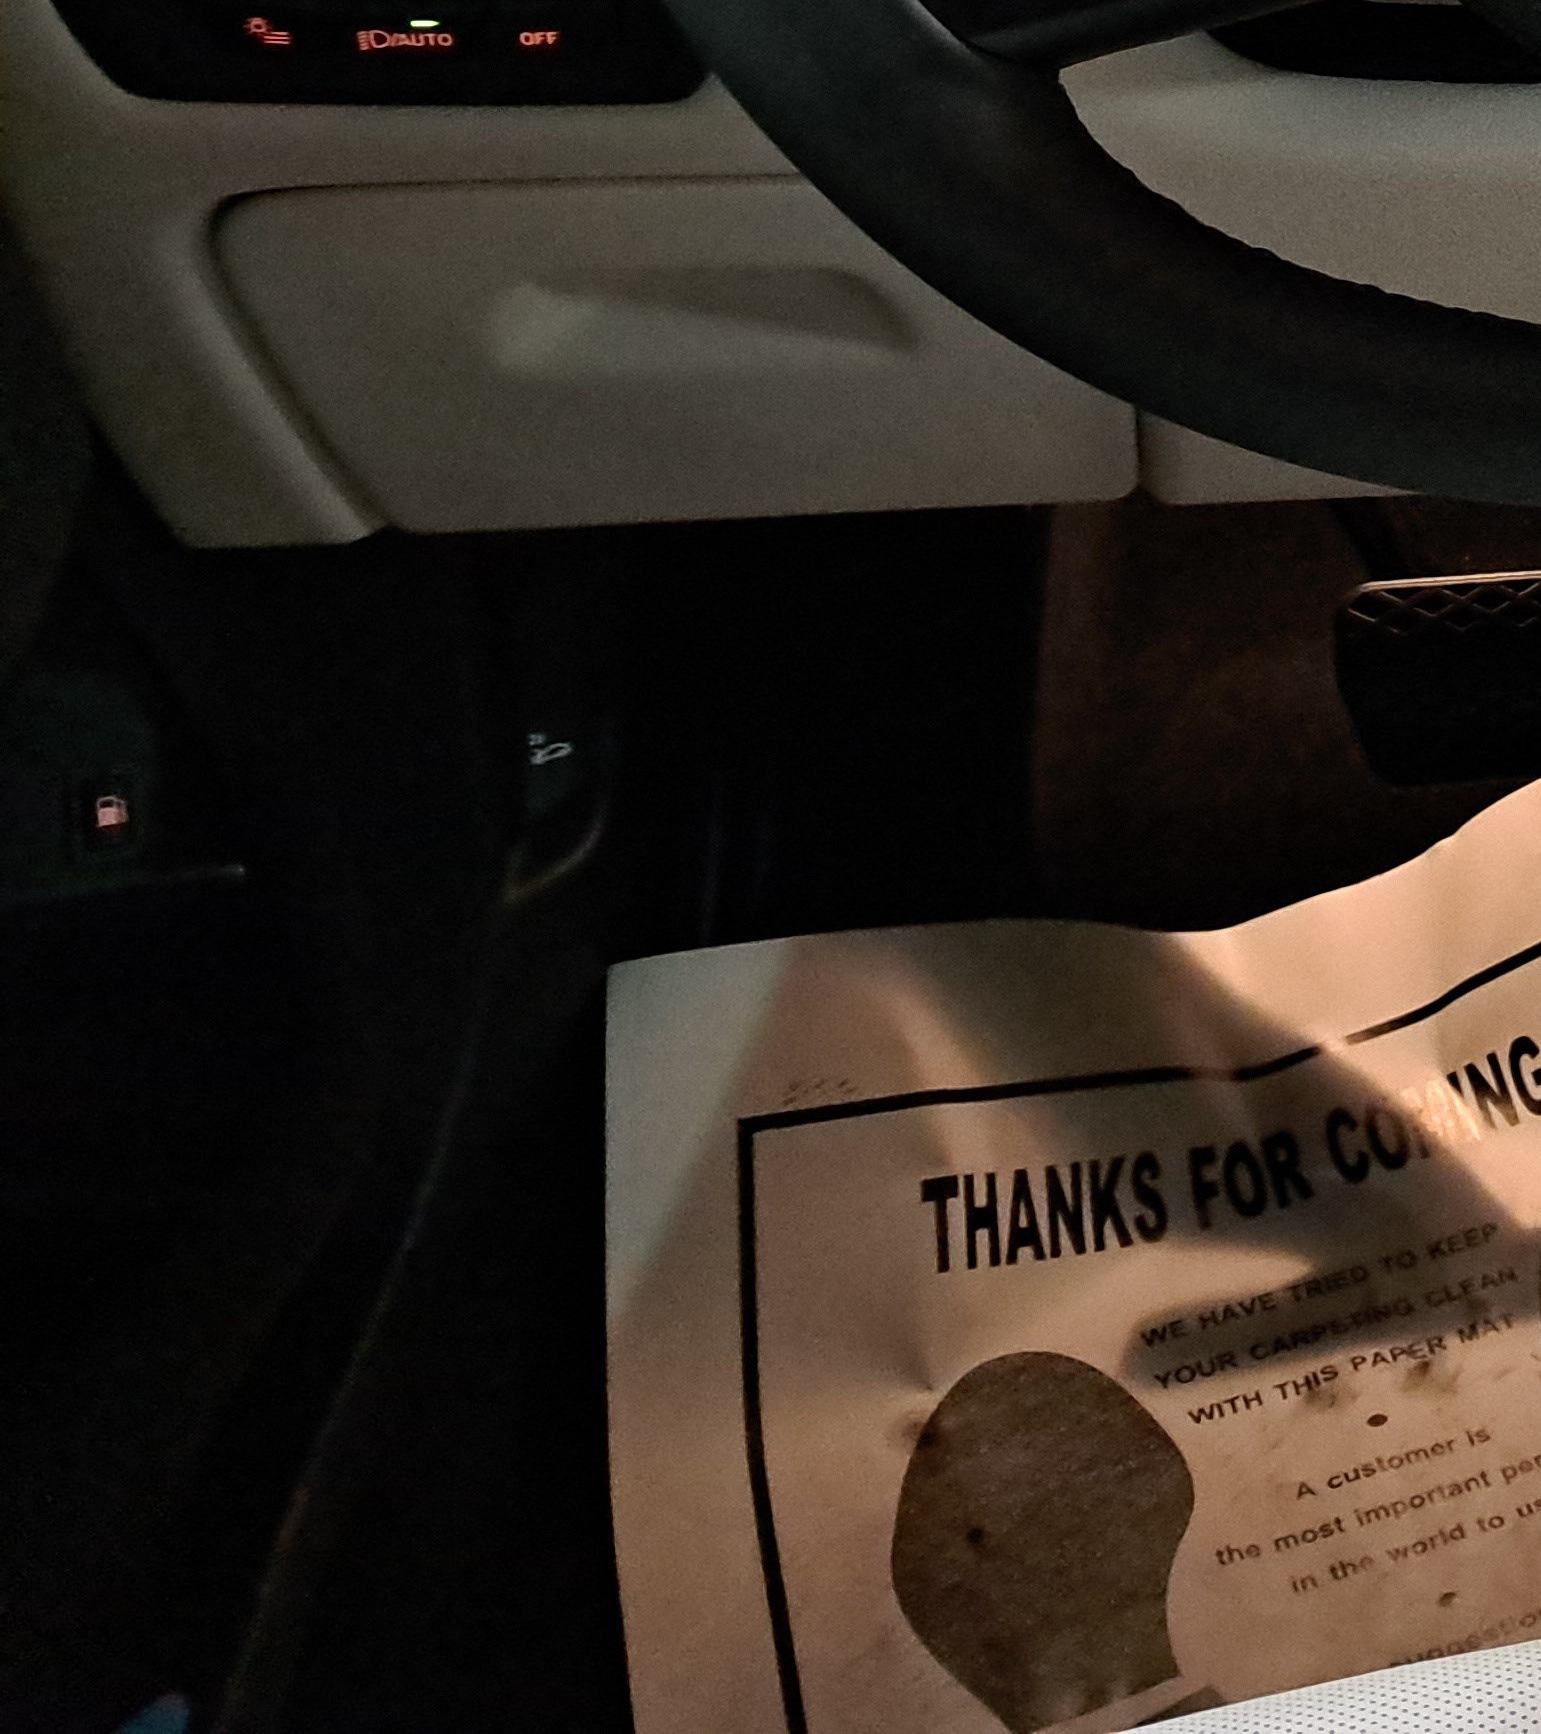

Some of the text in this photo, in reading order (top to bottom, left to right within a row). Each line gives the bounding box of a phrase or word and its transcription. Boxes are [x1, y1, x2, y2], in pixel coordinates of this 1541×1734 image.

[519, 30, 559, 46] OFF
[920, 1151, 1170, 1274] THANKS
[1188, 1129, 1314, 1232] FOR
[1140, 1222, 1499, 1349] WE HAVE TRIED TO KEEP
[1154, 1268, 1520, 1390] YOUR CARPETING CLEAN
[1187, 1314, 1515, 1425] WITH THIS PAPER MAT
[1296, 1427, 1493, 1500] A customer is
[1215, 1540, 1262, 1566] the
[1273, 1516, 1346, 1553] most
[1354, 1470, 1493, 1528] important
[1291, 1574, 1318, 1594] in
[1329, 1553, 1375, 1581] the
[1386, 1523, 1466, 1565] world
[1476, 1512, 1505, 1534] to
